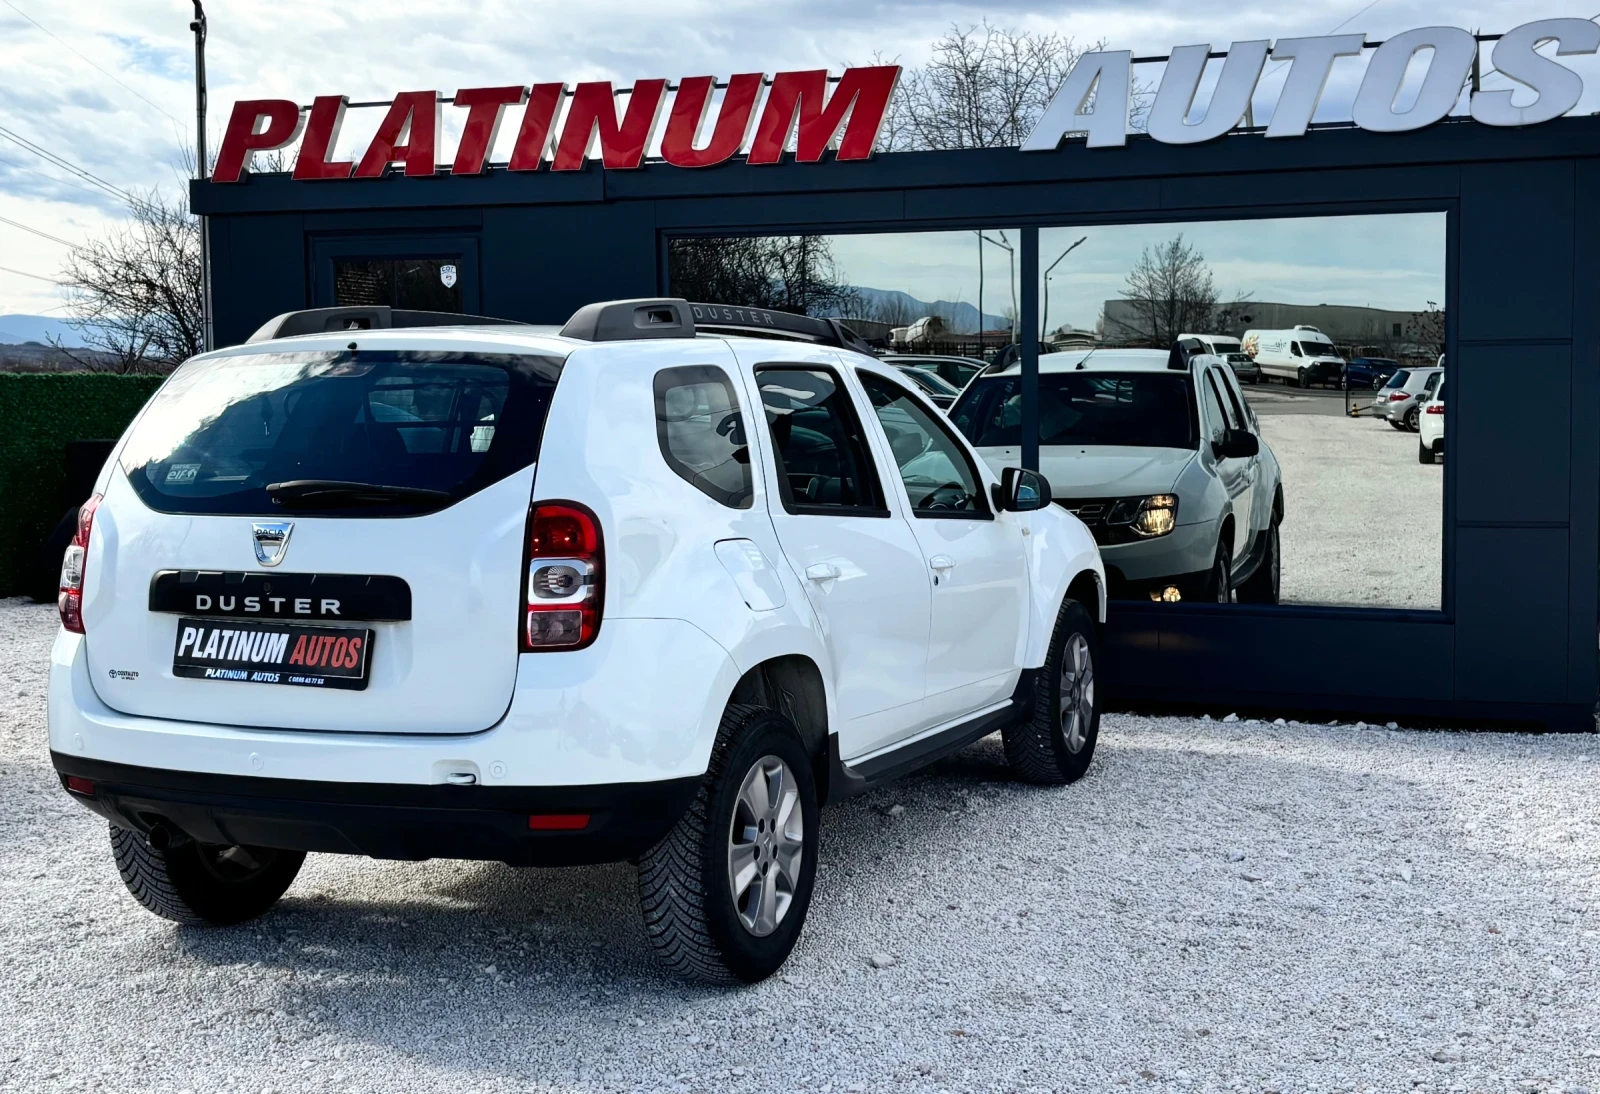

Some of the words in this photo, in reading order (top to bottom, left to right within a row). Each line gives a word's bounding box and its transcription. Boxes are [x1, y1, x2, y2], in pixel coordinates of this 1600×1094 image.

[211, 65, 903, 183] PLATINUM
[1019, 17, 1600, 151] AUTOS
[693, 306, 774, 324] DUSTER
[167, 470, 188, 480] elf
[196, 595, 342, 615] DUSTER
[177, 627, 290, 664] PLATINUM
[289, 634, 362, 669] AUTOS
[205, 668, 248, 680] PLATINUM
[250, 672, 280, 683] AUTOS
